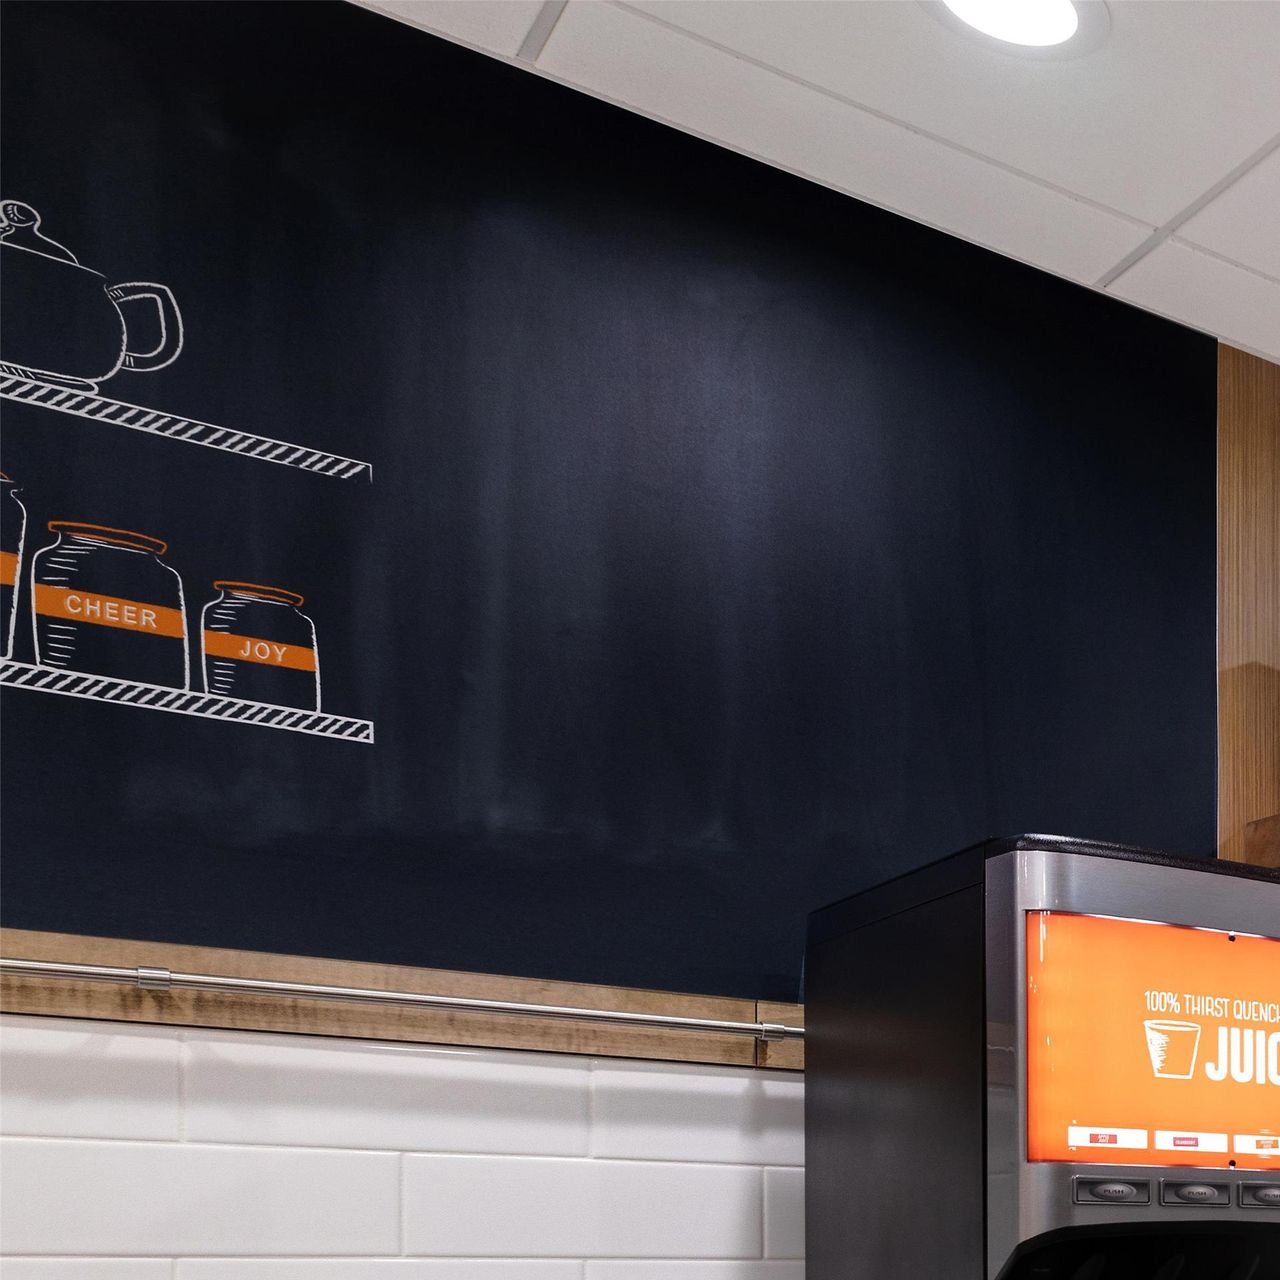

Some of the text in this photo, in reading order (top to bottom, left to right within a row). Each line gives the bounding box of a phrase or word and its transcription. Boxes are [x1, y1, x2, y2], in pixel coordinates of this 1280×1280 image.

[64, 594, 158, 628] CHEER
[240, 640, 287, 662] JOY
[1144, 990, 1181, 1013] 100%
[1184, 994, 1230, 1018] THIRST
